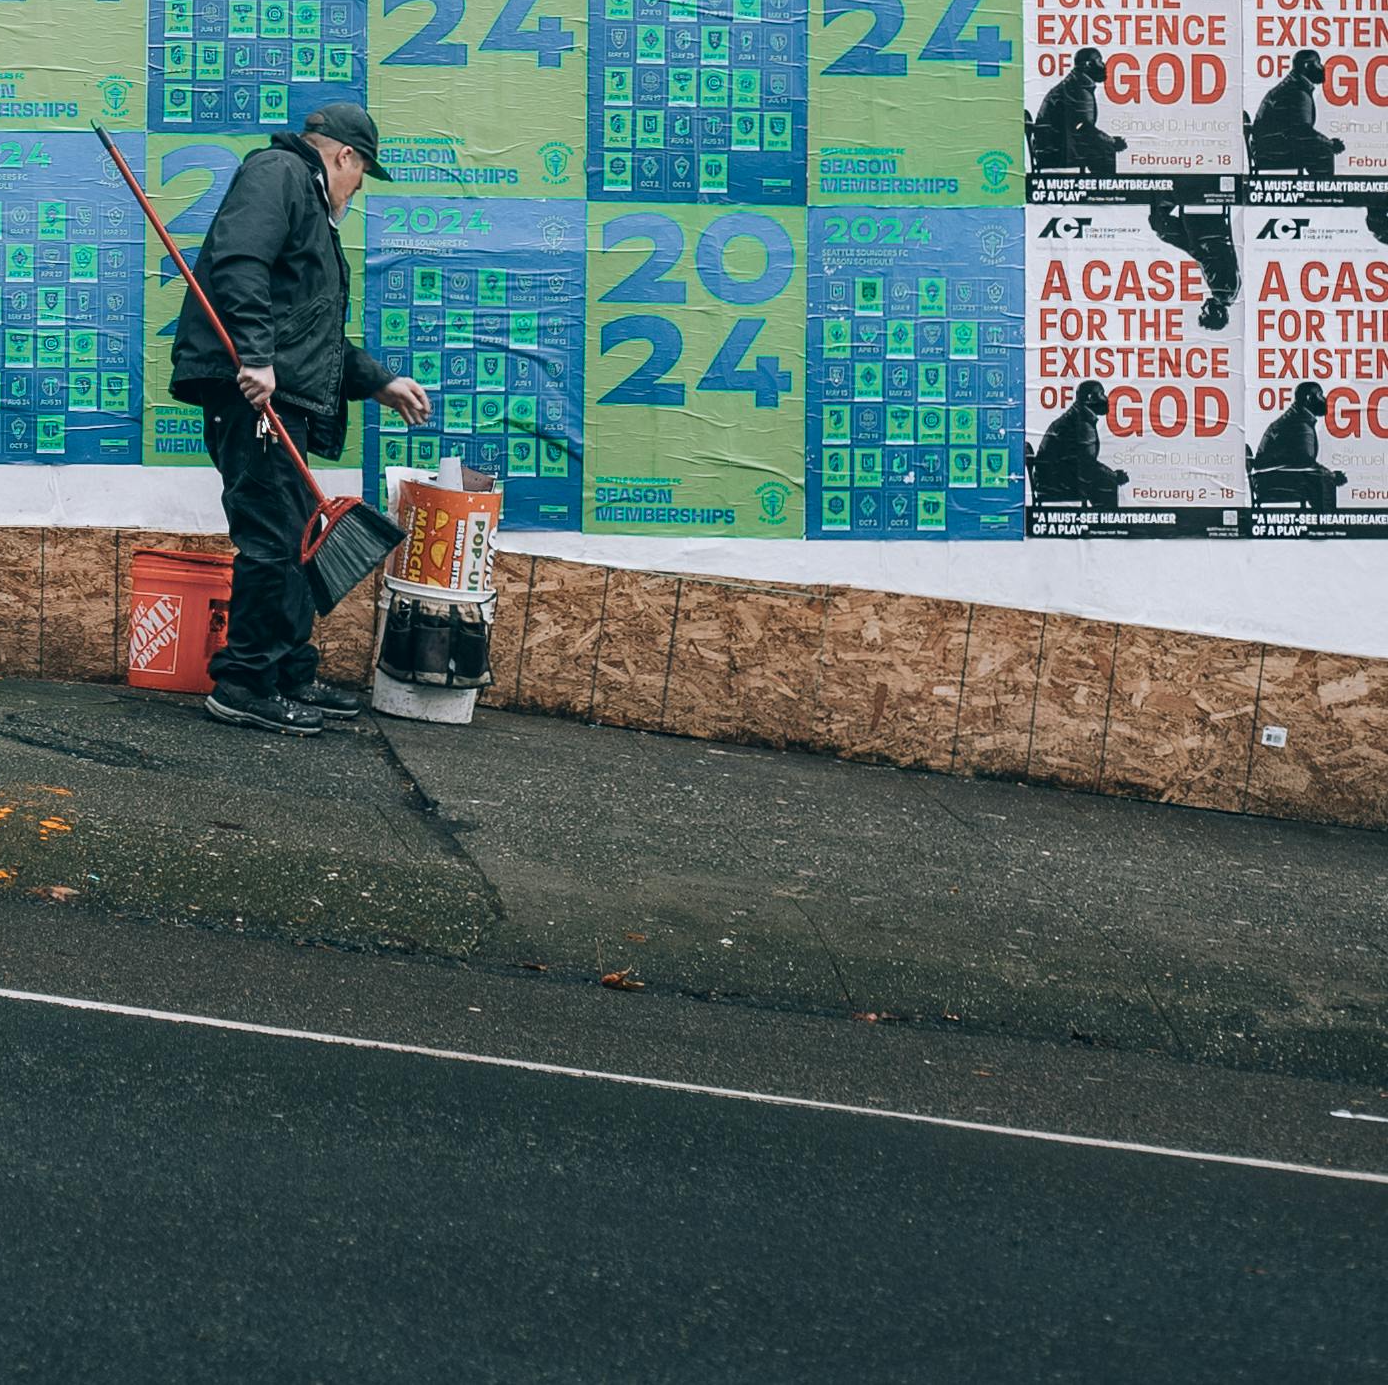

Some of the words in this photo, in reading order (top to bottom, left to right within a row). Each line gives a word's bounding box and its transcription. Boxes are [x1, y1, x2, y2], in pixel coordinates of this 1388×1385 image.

[1037, 15, 1227, 46] EXISTENCE
[1257, 55, 1290, 78] OF
[1038, 54, 1071, 77] OF
[1103, 52, 1227, 105] GOD
[1111, 118, 1164, 133] Samuel
[1184, 118, 1232, 133] Hunter
[1329, 121, 1383, 134] Samuel
[379, 148, 456, 164] SEASON
[1131, 154, 1192, 168] February
[1196, 155, 1204, 165] 2
[1217, 155, 1231, 165] 18
[820, 159, 896, 174] SEASON
[820, 178, 958, 194] MEMBERSHIPS
[1047, 180, 1097, 190] MUST-SEE
[1099, 180, 1173, 191] HEARTBREAKER
[1264, 180, 1315, 192] MUST-SEE
[1032, 191, 1046, 201] OF
[1048, 191, 1056, 201] A
[1249, 192, 1263, 203] OF
[1264, 192, 1273, 203] A
[382, 206, 492, 235] 2024
[1037, 217, 1092, 239] ACT
[823, 216, 932, 245] 2024
[1255, 218, 1310, 240] ACT
[598, 212, 795, 305] 20
[822, 249, 855, 257] SEATTLE
[854, 258, 894, 266] SCHEDULE
[1040, 260, 1072, 301] A
[1082, 260, 1204, 302] CASE
[1259, 261, 1290, 302] A
[1040, 308, 1107, 342] FOR
[1118, 308, 1184, 342] THE
[1258, 309, 1325, 342] FOR
[596, 315, 792, 408] 24
[1040, 348, 1229, 379] EXISTENCE
[1258, 387, 1292, 411] OF
[1040, 386, 1074, 410] OF
[1106, 386, 1229, 439] GOD
[155, 419, 203, 435] SEAS
[1113, 452, 1166, 466] Samuel
[1187, 453, 1235, 466] Hunter
[1331, 454, 1385, 467] Samuel
[595, 487, 672, 503] SEASON
[1133, 487, 1194, 502] February
[1198, 488, 1207, 499] 2
[1220, 488, 1234, 499] 18
[595, 506, 735, 524] MEMBERSHIPS
[1048, 513, 1099, 524] MUST-SEE
[1100, 513, 1177, 525] HEARTBREAKER
[1267, 514, 1318, 525] MUST-SEE
[1320, 514, 1388, 526] HEARTBREAKE
[1033, 525, 1047, 535] OF
[1048, 525, 1057, 535] A
[1252, 526, 1266, 536] OF
[1267, 526, 1276, 536] A
[408, 507, 429, 583] MARCH
[137, 625, 178, 670] DEPOT
